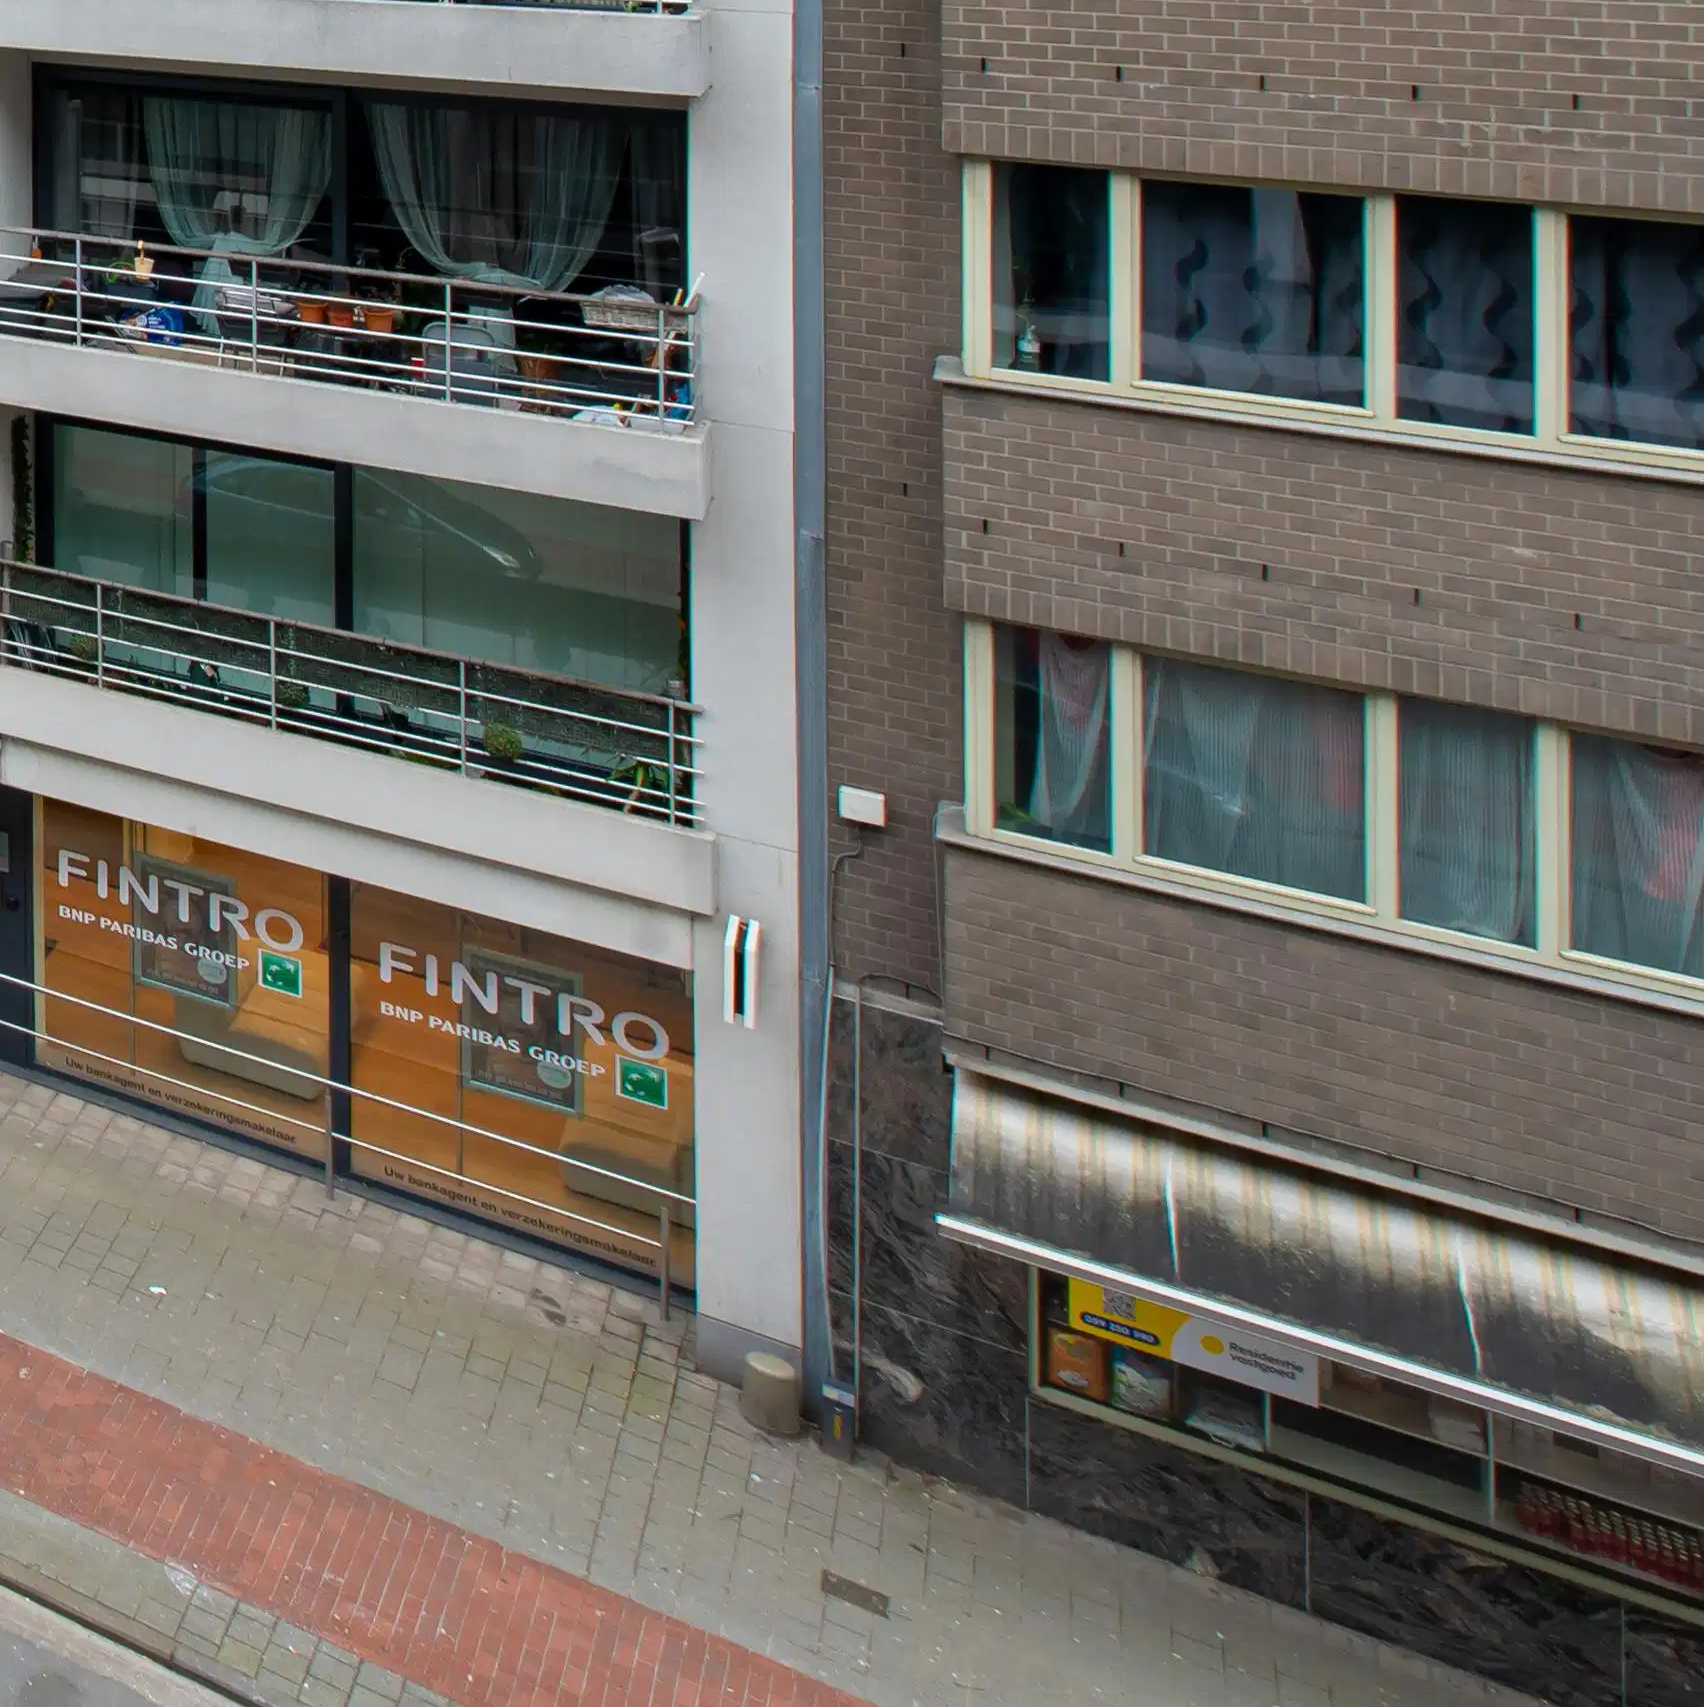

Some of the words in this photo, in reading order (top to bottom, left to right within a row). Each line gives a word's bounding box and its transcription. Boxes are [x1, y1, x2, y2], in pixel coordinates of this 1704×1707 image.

[57, 848, 304, 952] FINTRO
[58, 904, 96, 925] BNP
[99, 916, 178, 951] PARIBAS
[183, 943, 250, 970] GROEP
[378, 941, 670, 1060] FINTRO
[379, 1000, 424, 1024] BNP
[428, 1014, 521, 1054] PARIBAS
[528, 1045, 606, 1078] GROEP
[65, 1055, 84, 1070] Uw
[86, 1064, 146, 1093] bankagent
[148, 1086, 163, 1098] en
[163, 1092, 297, 1144] verzekeringsmakelaar
[383, 1164, 405, 1181] Uw
[407, 1173, 478, 1210] bankagent
[480, 1200, 498, 1214] en
[500, 1207, 658, 1268] verzekeringsmakelaar
